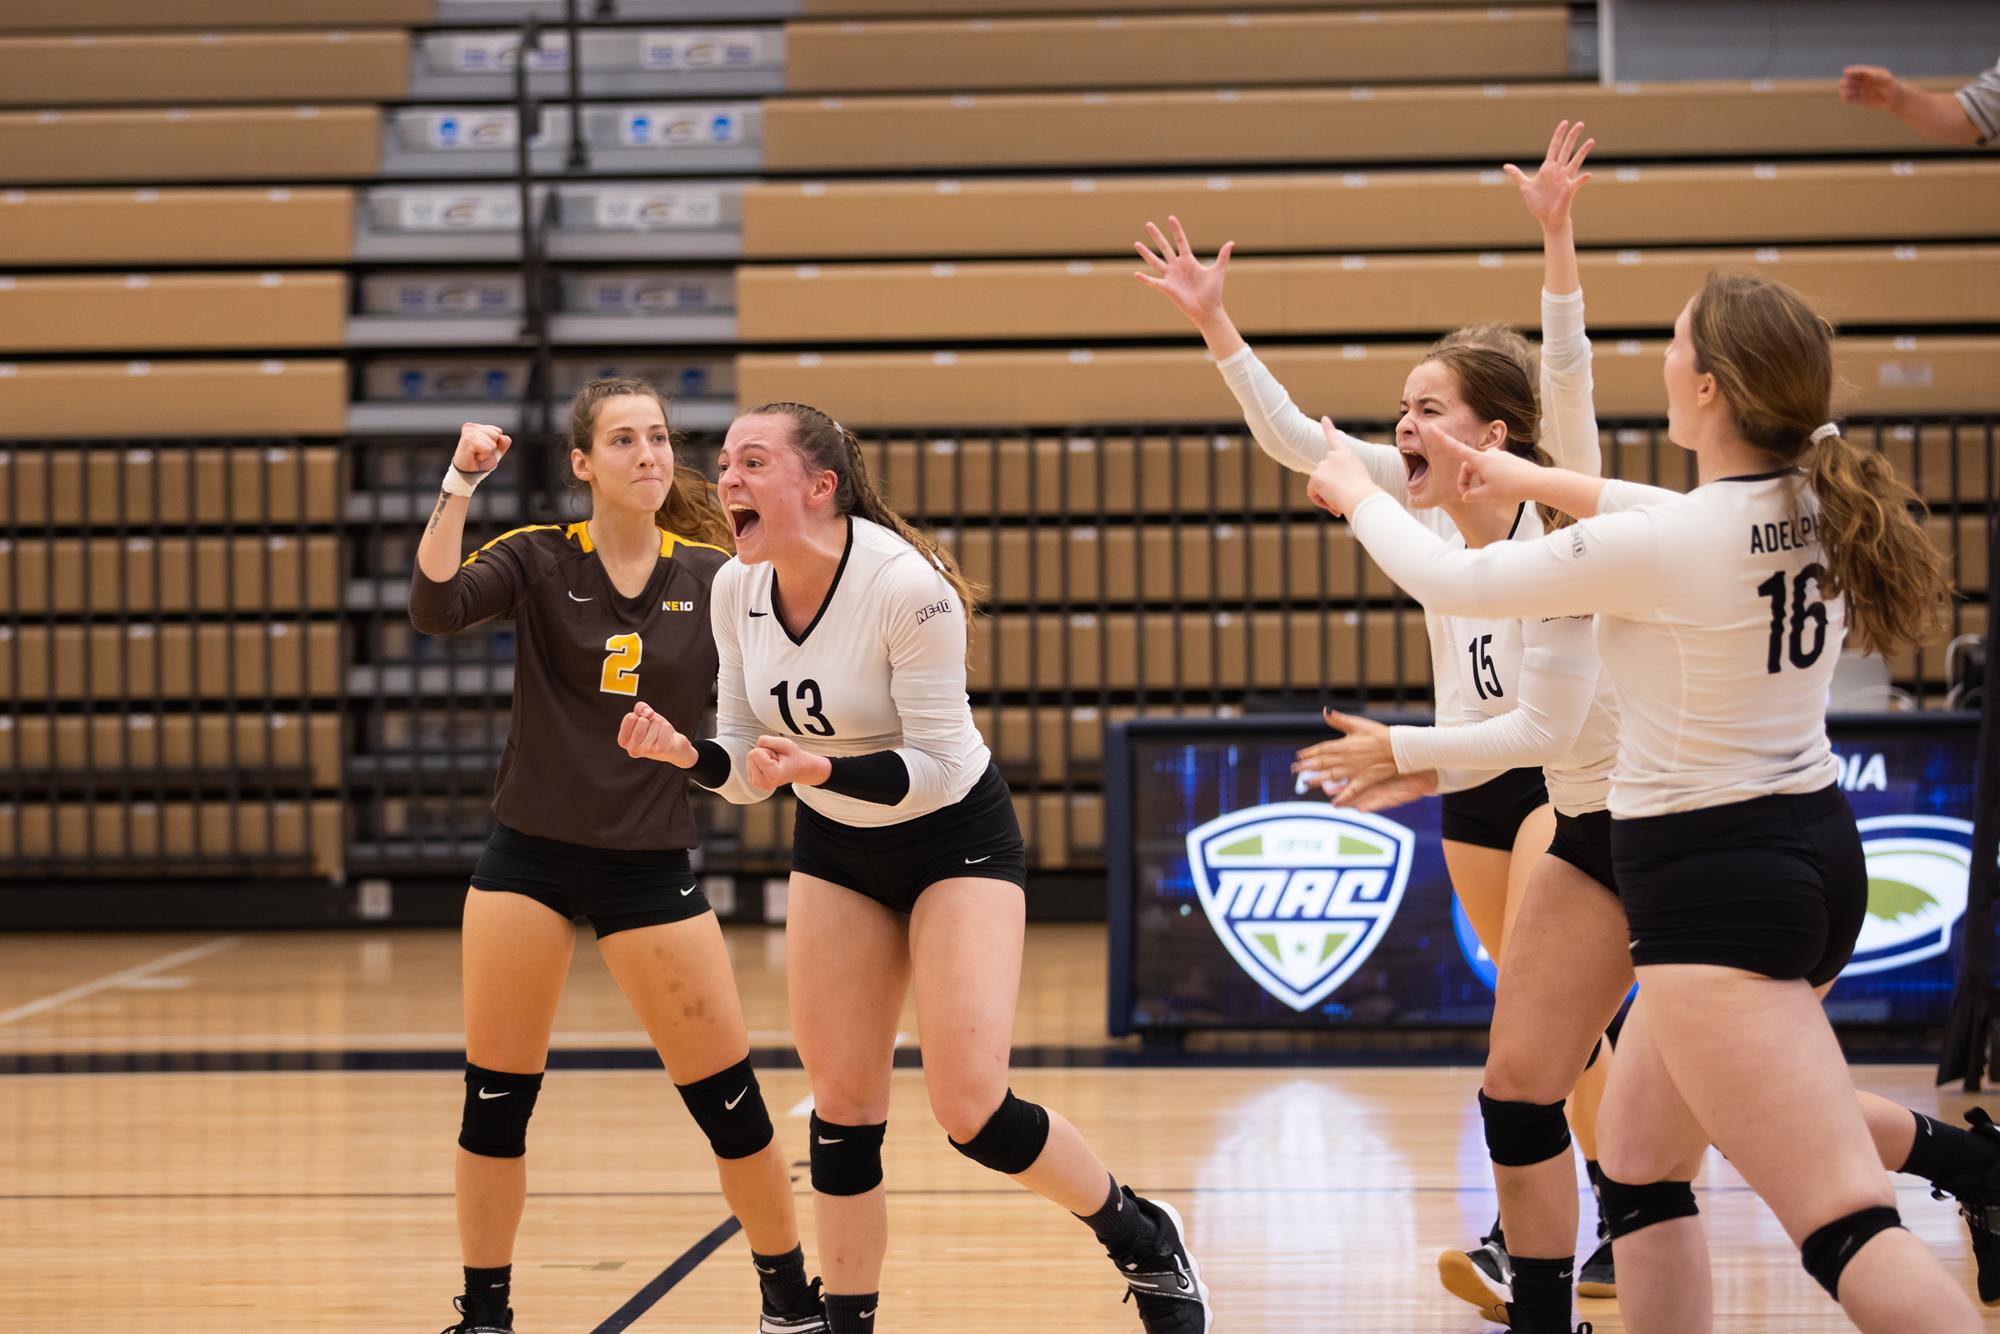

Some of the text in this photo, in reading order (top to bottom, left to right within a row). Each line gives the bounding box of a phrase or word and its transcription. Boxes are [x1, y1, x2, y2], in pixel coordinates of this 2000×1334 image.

[661, 600, 694, 612] NE10
[914, 599, 952, 625] NE-10
[1757, 562, 1828, 674] 16
[600, 631, 643, 697] 2
[1468, 633, 1504, 700] 15
[770, 678, 836, 737] 13
[1215, 868, 1388, 919] MAC
